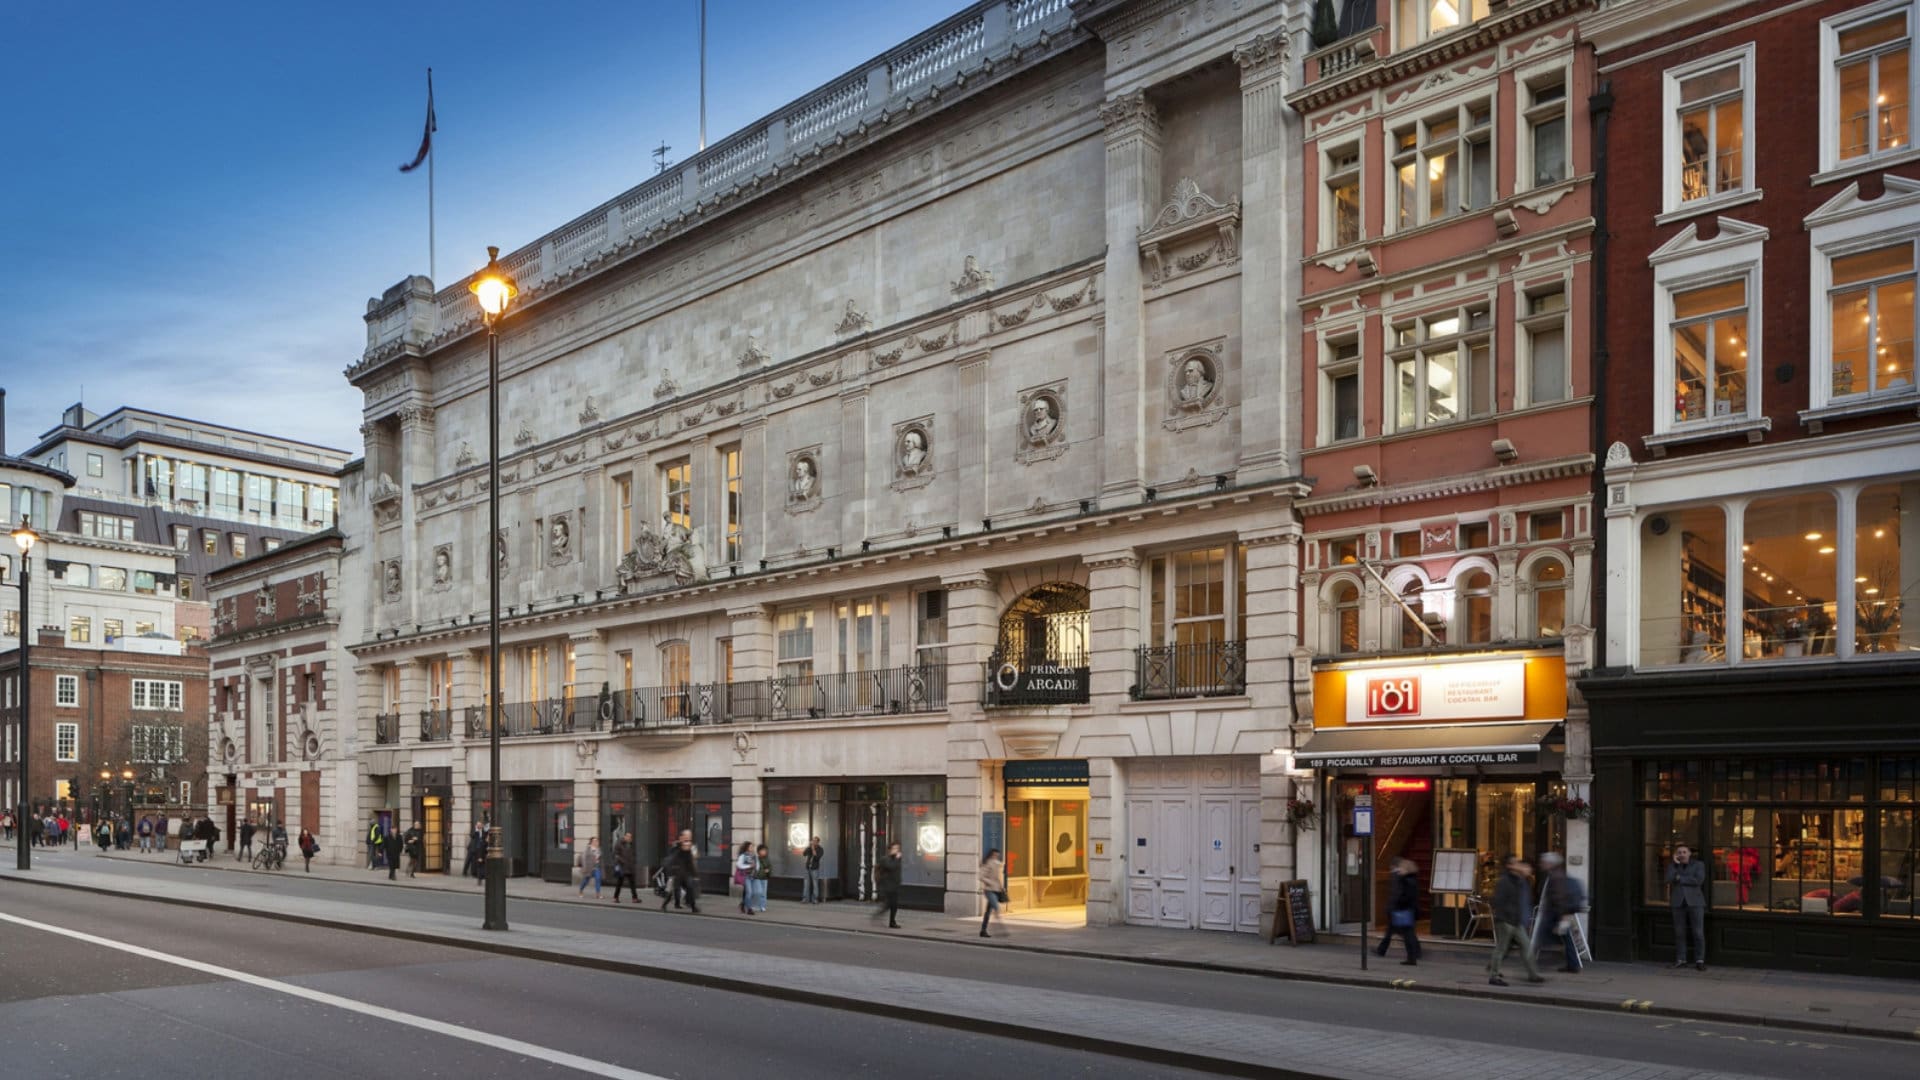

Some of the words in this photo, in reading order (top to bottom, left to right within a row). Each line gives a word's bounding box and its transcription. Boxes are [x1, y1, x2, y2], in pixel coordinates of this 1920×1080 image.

[1027, 679, 1079, 690] ARCADE
[1372, 680, 1413, 712] 189
[1327, 758, 1374, 767] PICCADILLY
[1381, 756, 1438, 766] RESTAURANT
[1440, 755, 1446, 763] &
[1449, 754, 1495, 764] COCKTAIL
[1498, 753, 1518, 762] BAR
